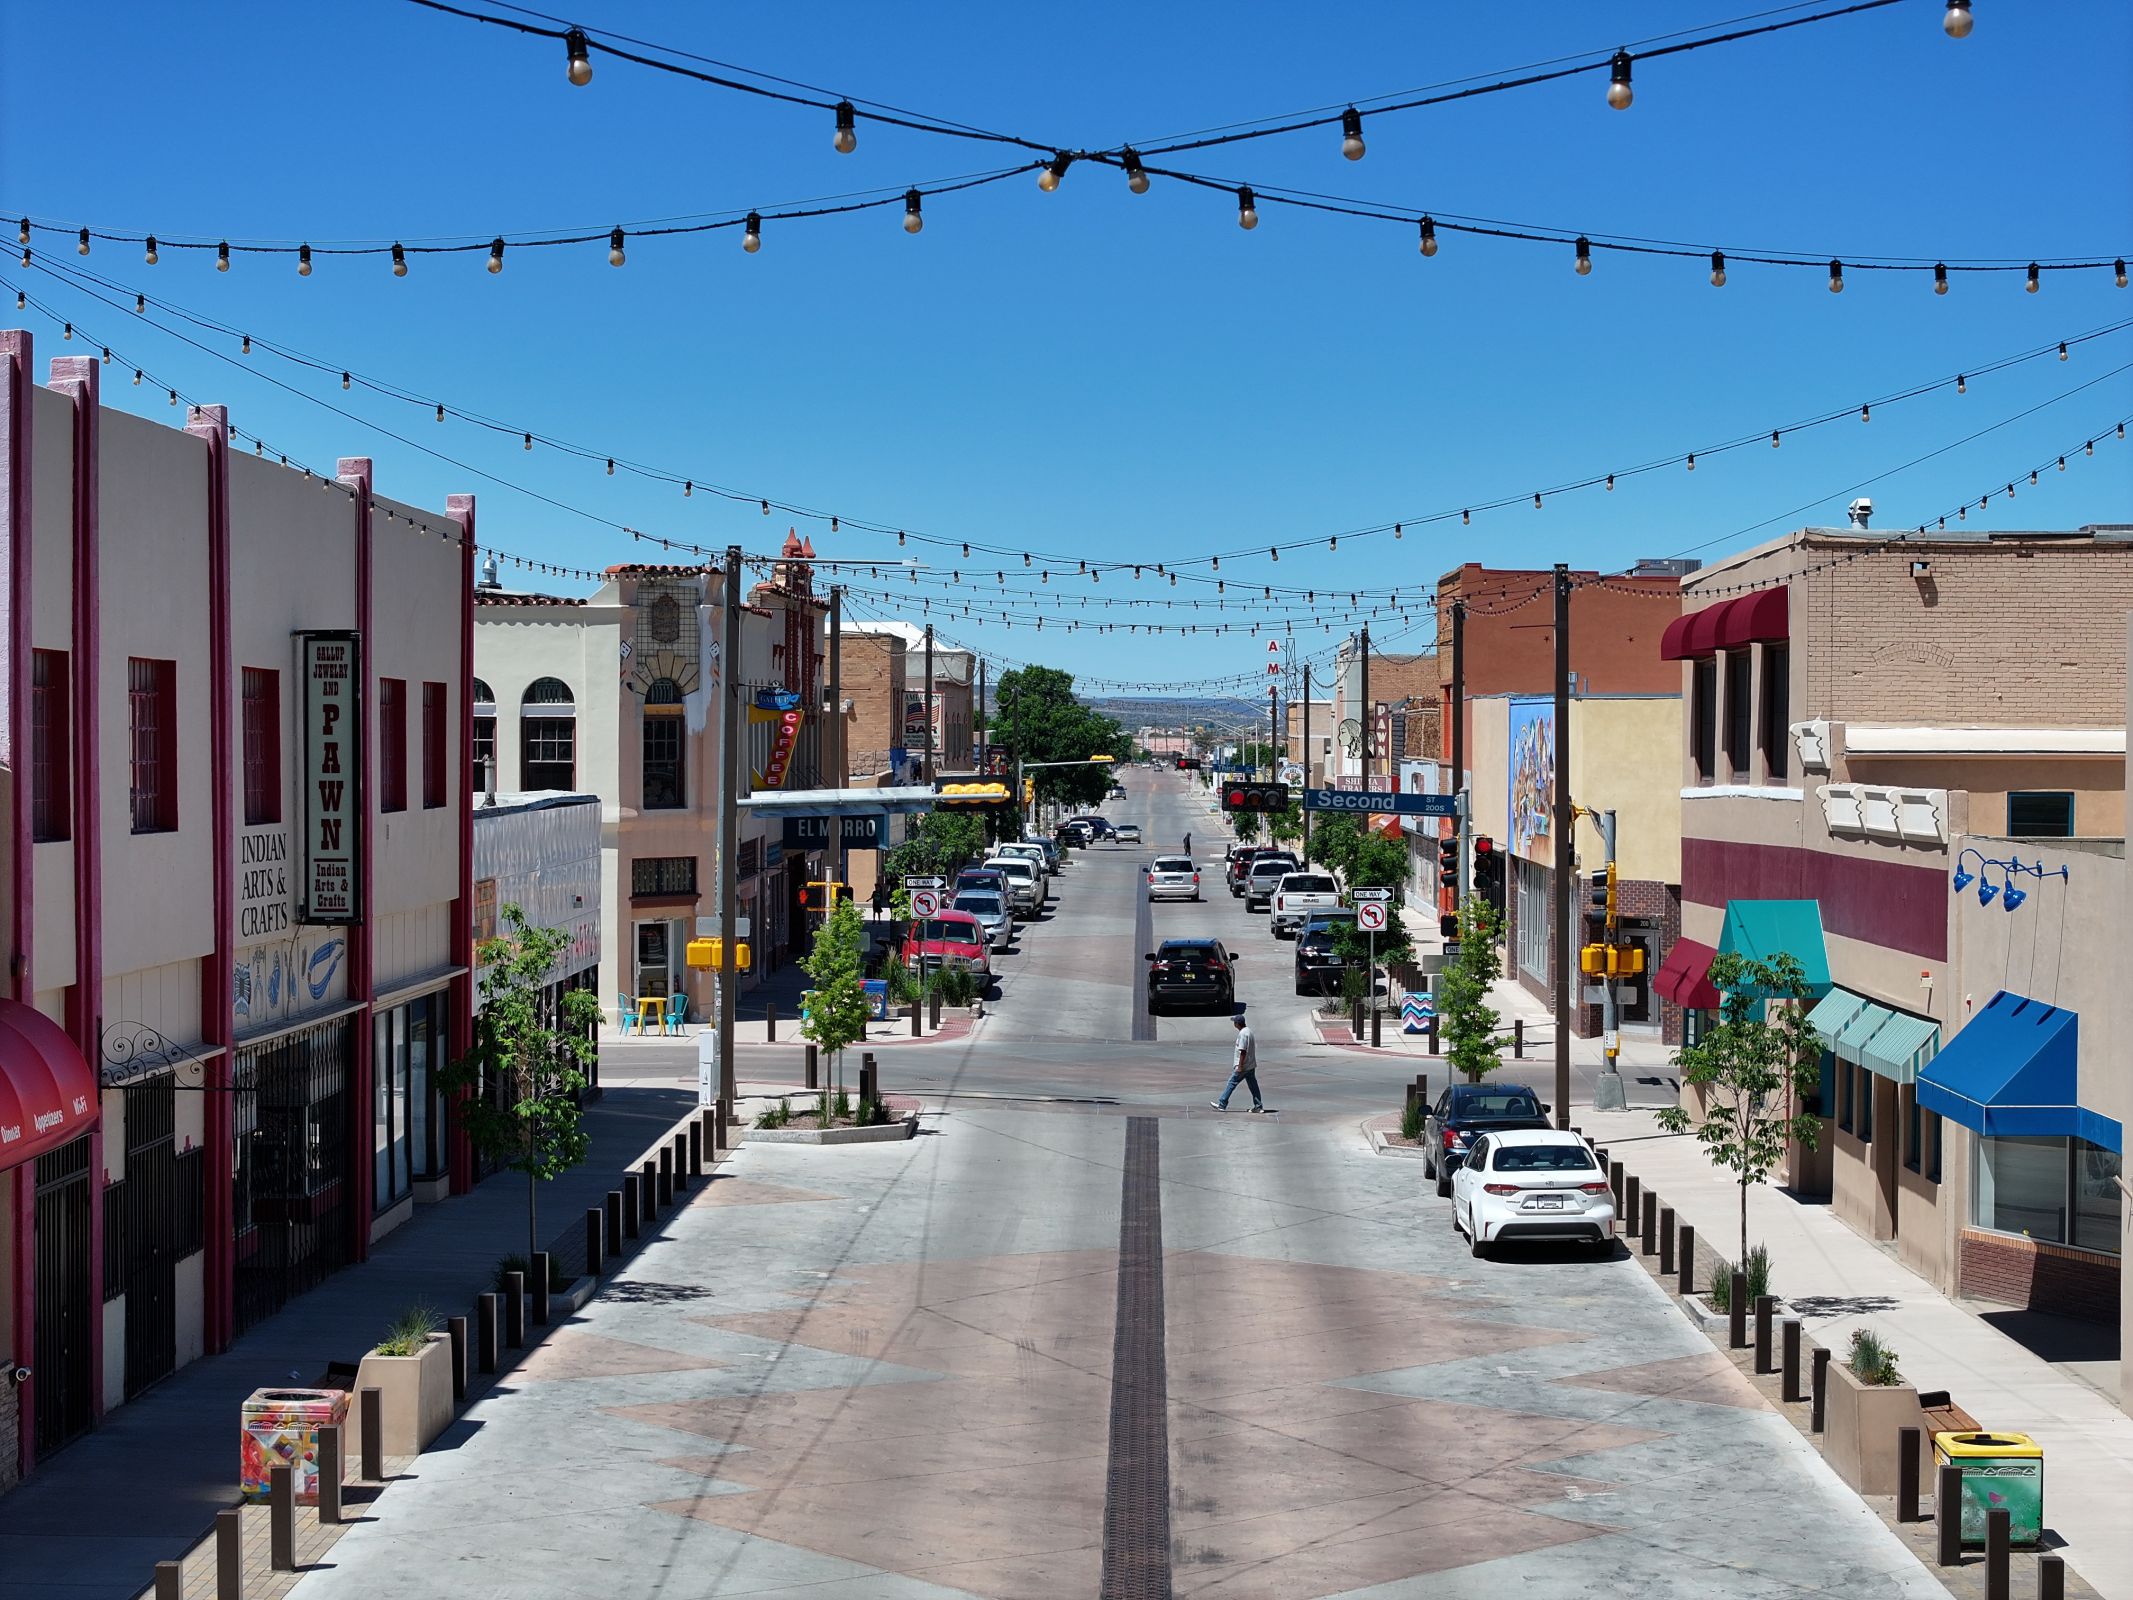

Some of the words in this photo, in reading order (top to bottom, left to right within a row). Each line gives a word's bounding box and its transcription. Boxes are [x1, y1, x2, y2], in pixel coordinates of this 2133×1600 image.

[317, 646, 345, 661] GALLUP
[313, 664, 348, 679] JEWELRY
[323, 681, 339, 696] AND
[1376, 705, 1387, 756] PAWN
[767, 713, 797, 784] COFFEE
[319, 704, 344, 850] PAWN
[1345, 777, 1378, 786] SHIA
[1341, 785, 1383, 793] TRAERS
[1317, 790, 1395, 810] Second
[798, 819, 814, 837] EL
[819, 819, 876, 837] MRRO
[241, 832, 286, 864] INDIAN
[317, 863, 346, 877] Indian
[242, 868, 274, 900] ARTS
[277, 867, 287, 895] &
[314, 879, 335, 892] Arts
[340, 879, 349, 892] &
[317, 894, 346, 908] Crafts
[241, 902, 288, 937] CRAFTS
[33, 1110, 64, 1134] Appetizers
